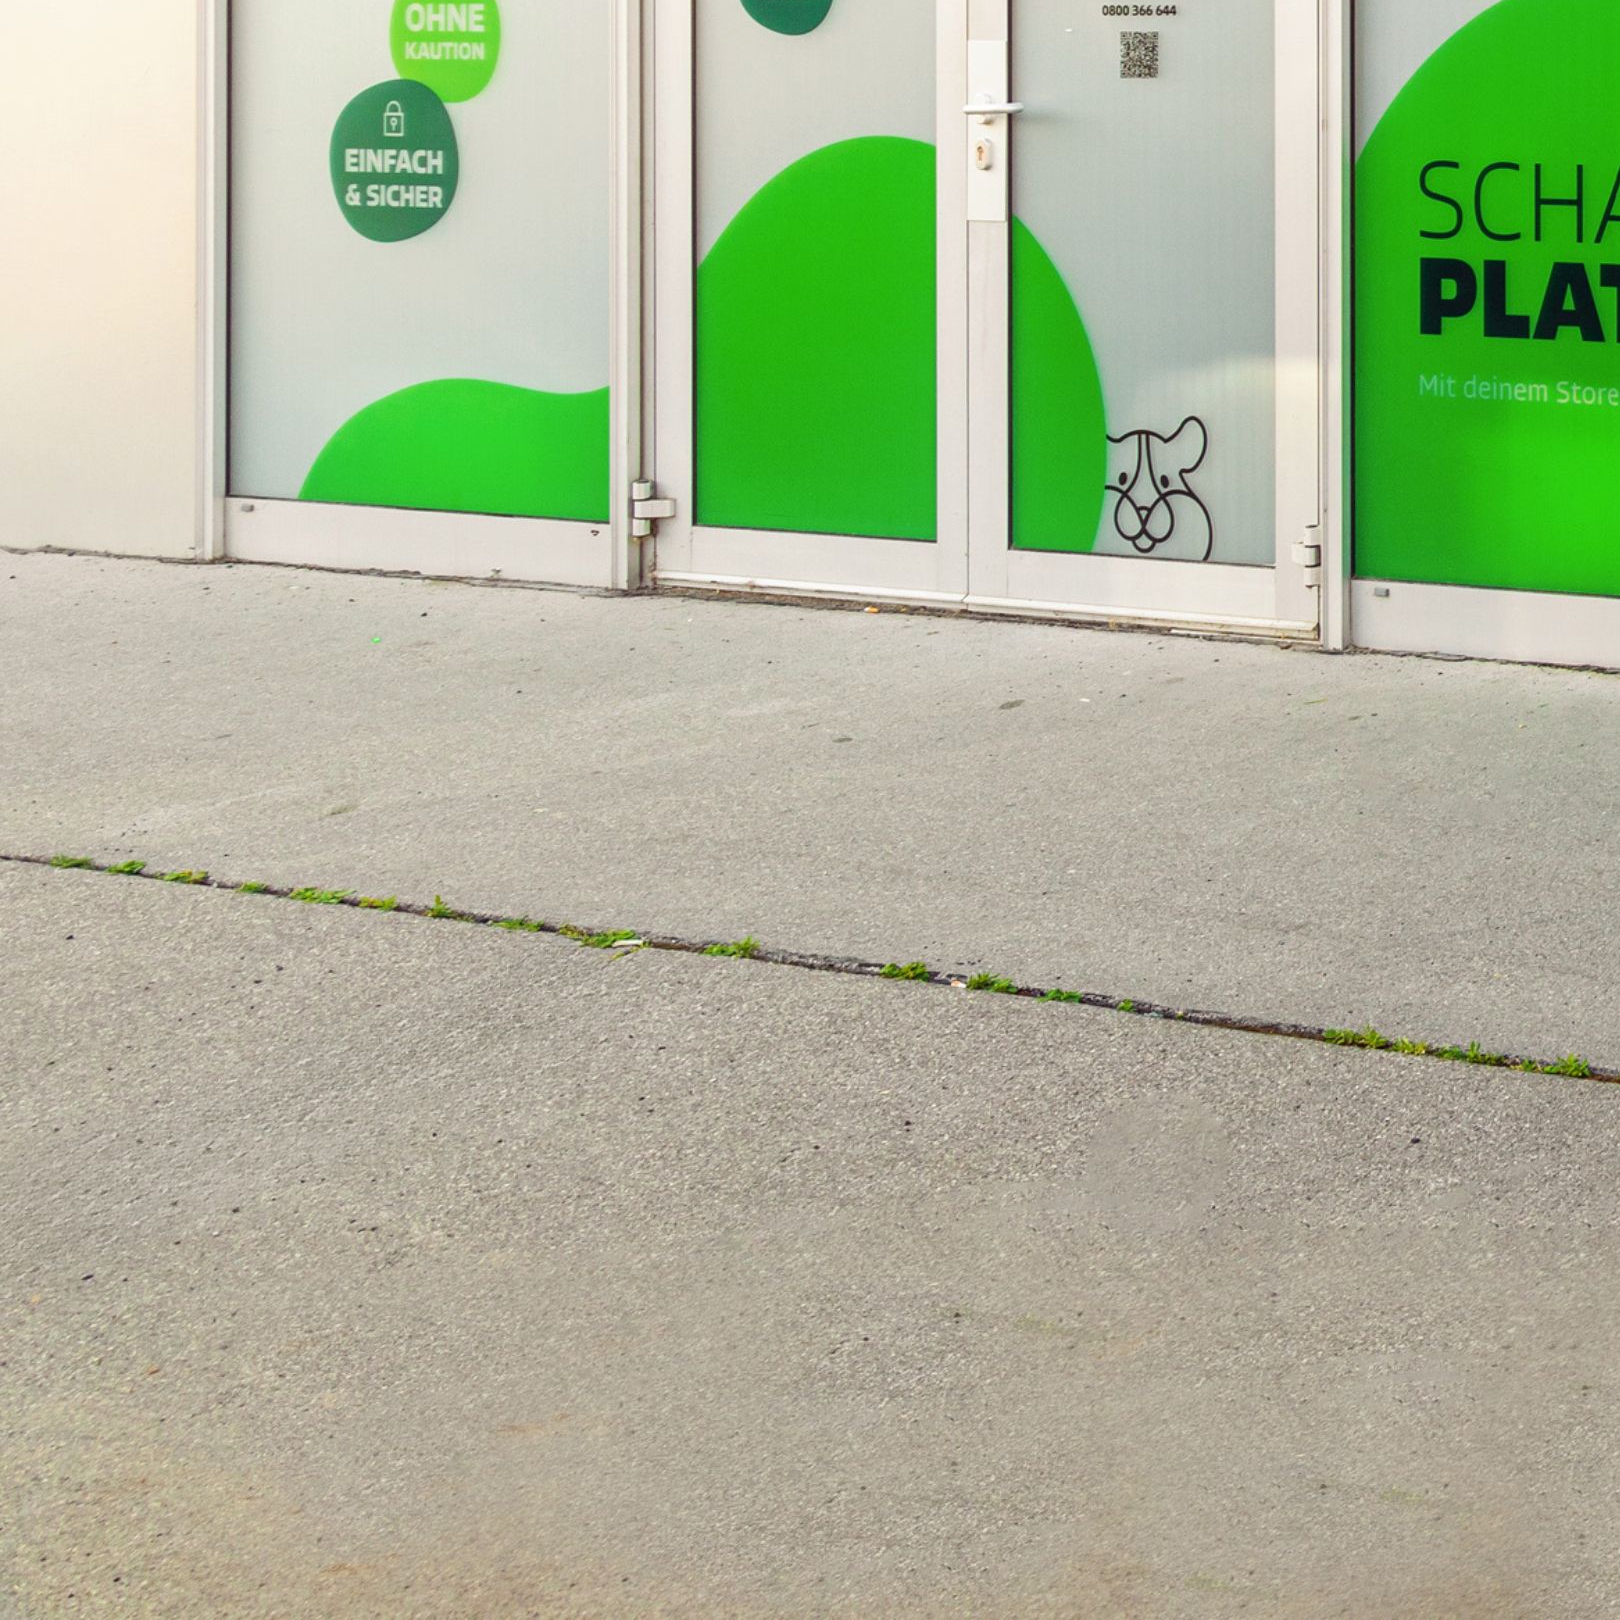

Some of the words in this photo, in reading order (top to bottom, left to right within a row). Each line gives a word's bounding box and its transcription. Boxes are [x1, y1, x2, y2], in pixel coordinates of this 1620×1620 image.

[405, 3, 485, 32] OHNE
[1102, 5, 1129, 16] 0800
[1132, 5, 1153, 16] 366
[1155, 5, 1177, 16] 644
[404, 42, 484, 60] KAUTION
[344, 148, 443, 174] EINFACH
[345, 184, 361, 206] &
[366, 184, 443, 208] SICHER
[1418, 373, 1456, 400] Mit
[1463, 375, 1548, 402] deinem
